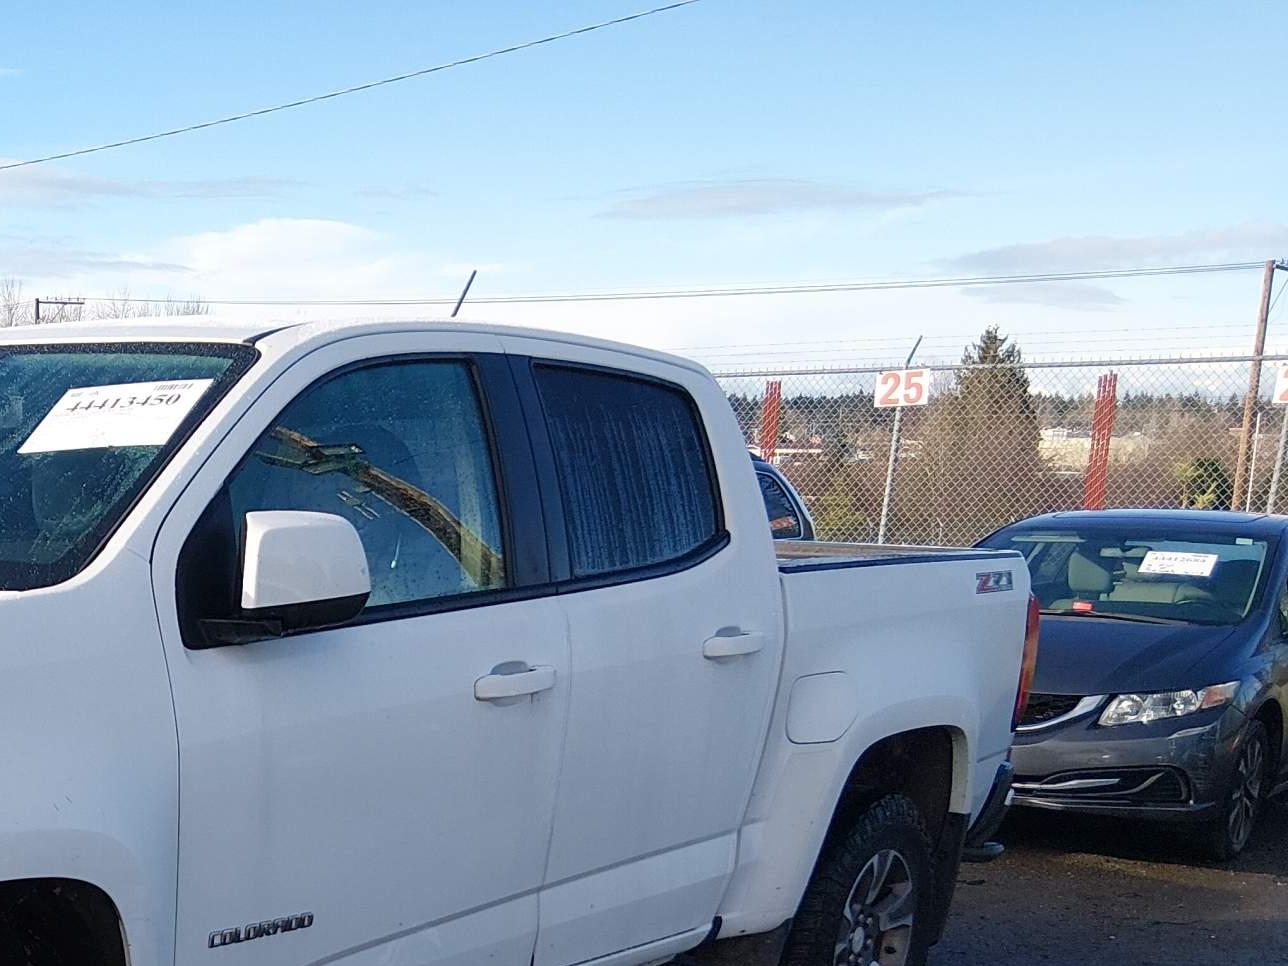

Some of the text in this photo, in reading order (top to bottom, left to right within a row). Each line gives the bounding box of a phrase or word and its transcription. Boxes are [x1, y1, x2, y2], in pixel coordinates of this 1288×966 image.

[66, 393, 181, 412] 44413450
[880, 371, 923, 405] 25
[976, 570, 1013, 594] Z71
[208, 911, 314, 948] COLORADO
